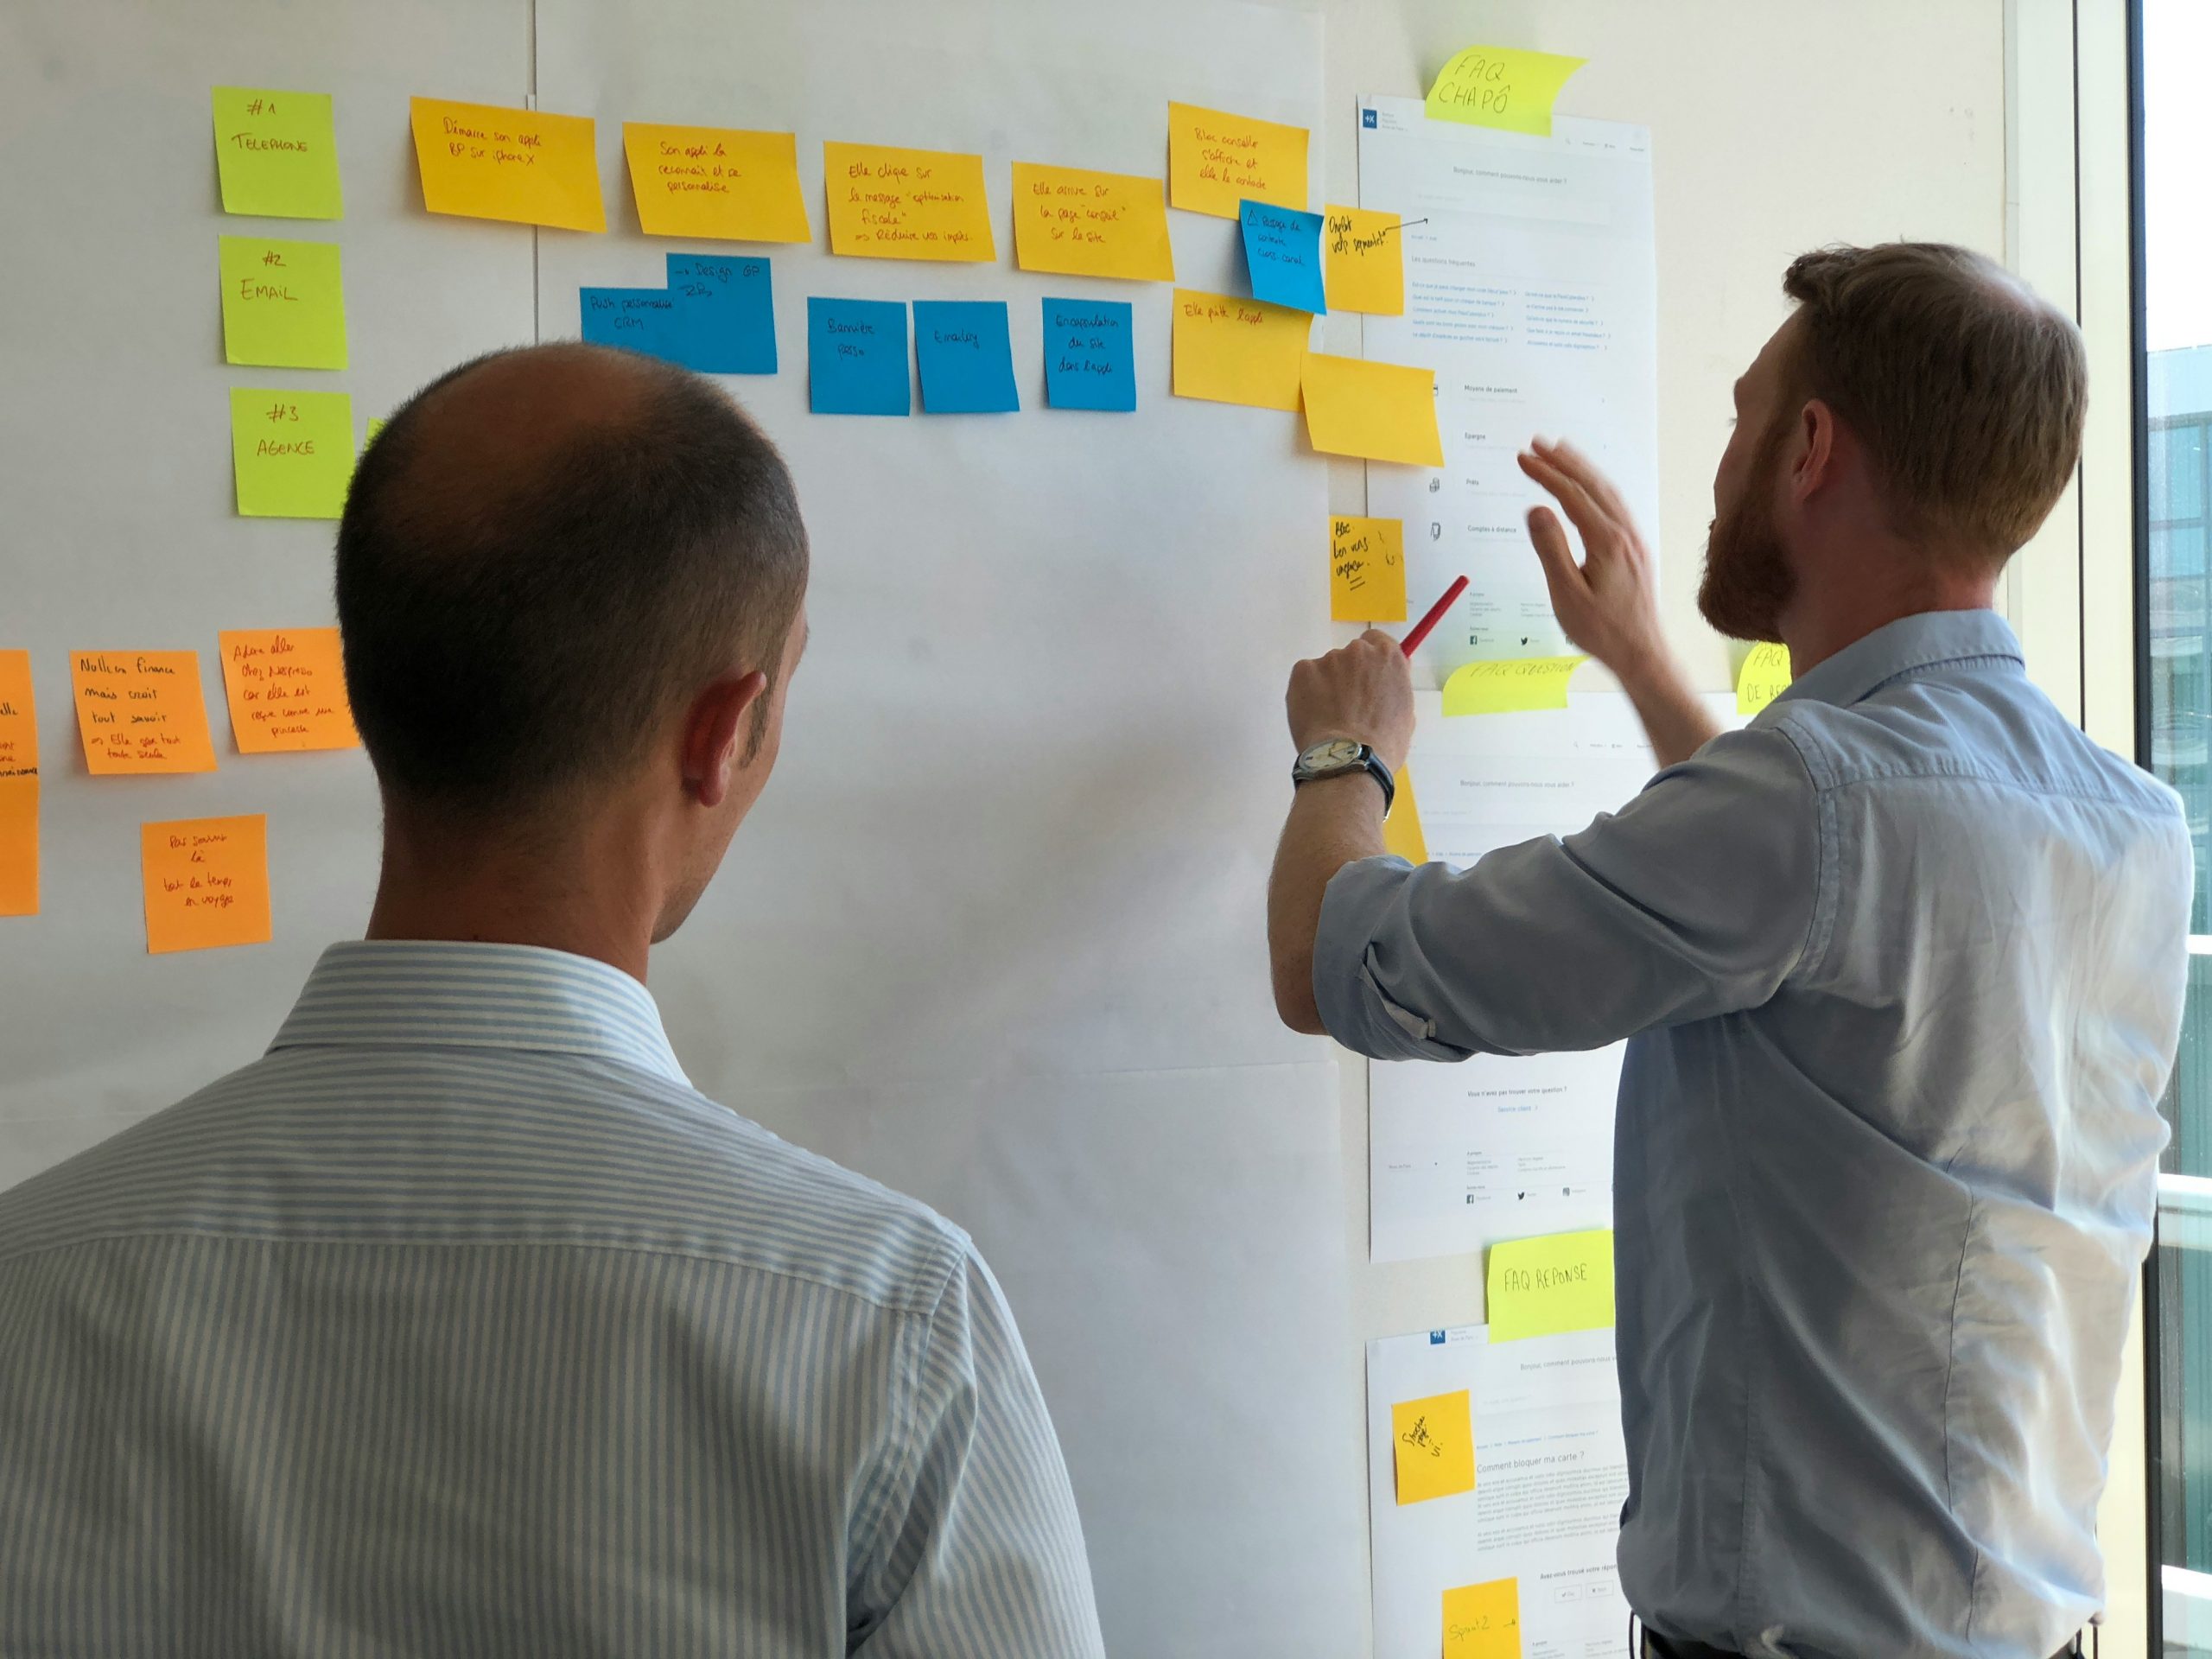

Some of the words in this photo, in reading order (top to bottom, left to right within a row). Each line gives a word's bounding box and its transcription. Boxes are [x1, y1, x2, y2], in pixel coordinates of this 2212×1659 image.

[1454, 54, 1505, 82] FAQ
[1438, 81, 1510, 114] CHAPÔ
[231, 132, 308, 152] TELEPHONE
[262, 250, 287, 267] #2
[256, 439, 316, 458] AGENCE
[1752, 648, 1784, 668] FAQ
[1746, 683, 1762, 702] DE
[1503, 1268, 1531, 1293] FAQ
[1535, 1262, 1588, 1291] REPONSE
[1477, 1460, 1512, 1474] Comment
[1513, 1457, 1541, 1470] bloquer
[1544, 1456, 1555, 1465] ma
[1558, 1452, 1578, 1463] carte
